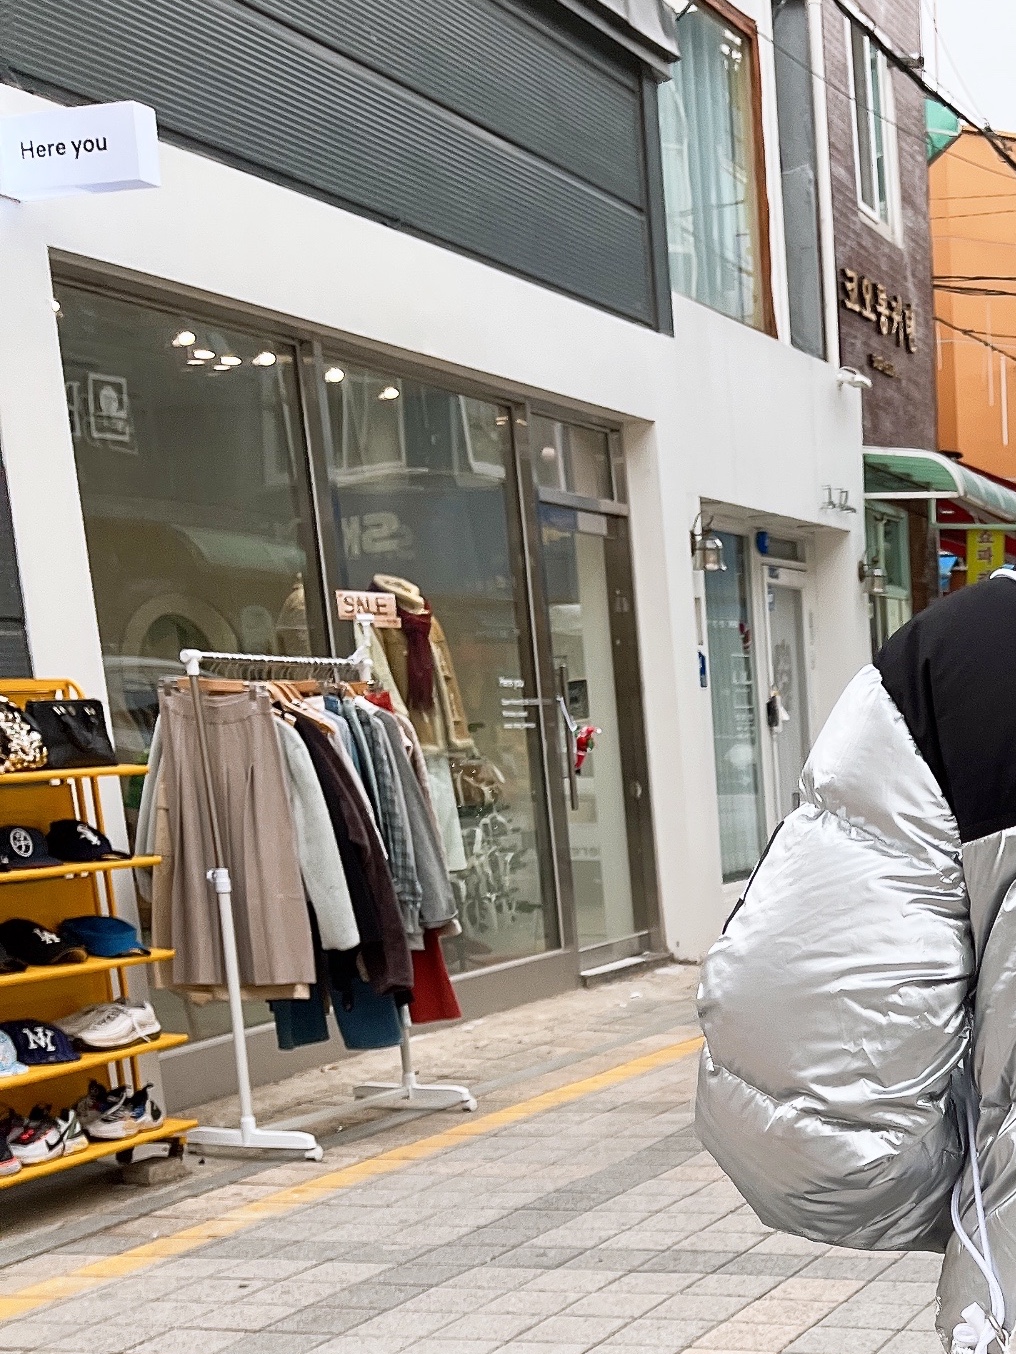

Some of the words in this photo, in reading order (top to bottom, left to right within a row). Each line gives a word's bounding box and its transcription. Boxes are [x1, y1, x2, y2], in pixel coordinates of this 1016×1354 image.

[20, 140, 66, 159] Here
[70, 137, 108, 159] you
[343, 596, 388, 616] SALE
[23, 1027, 56, 1051] NY
